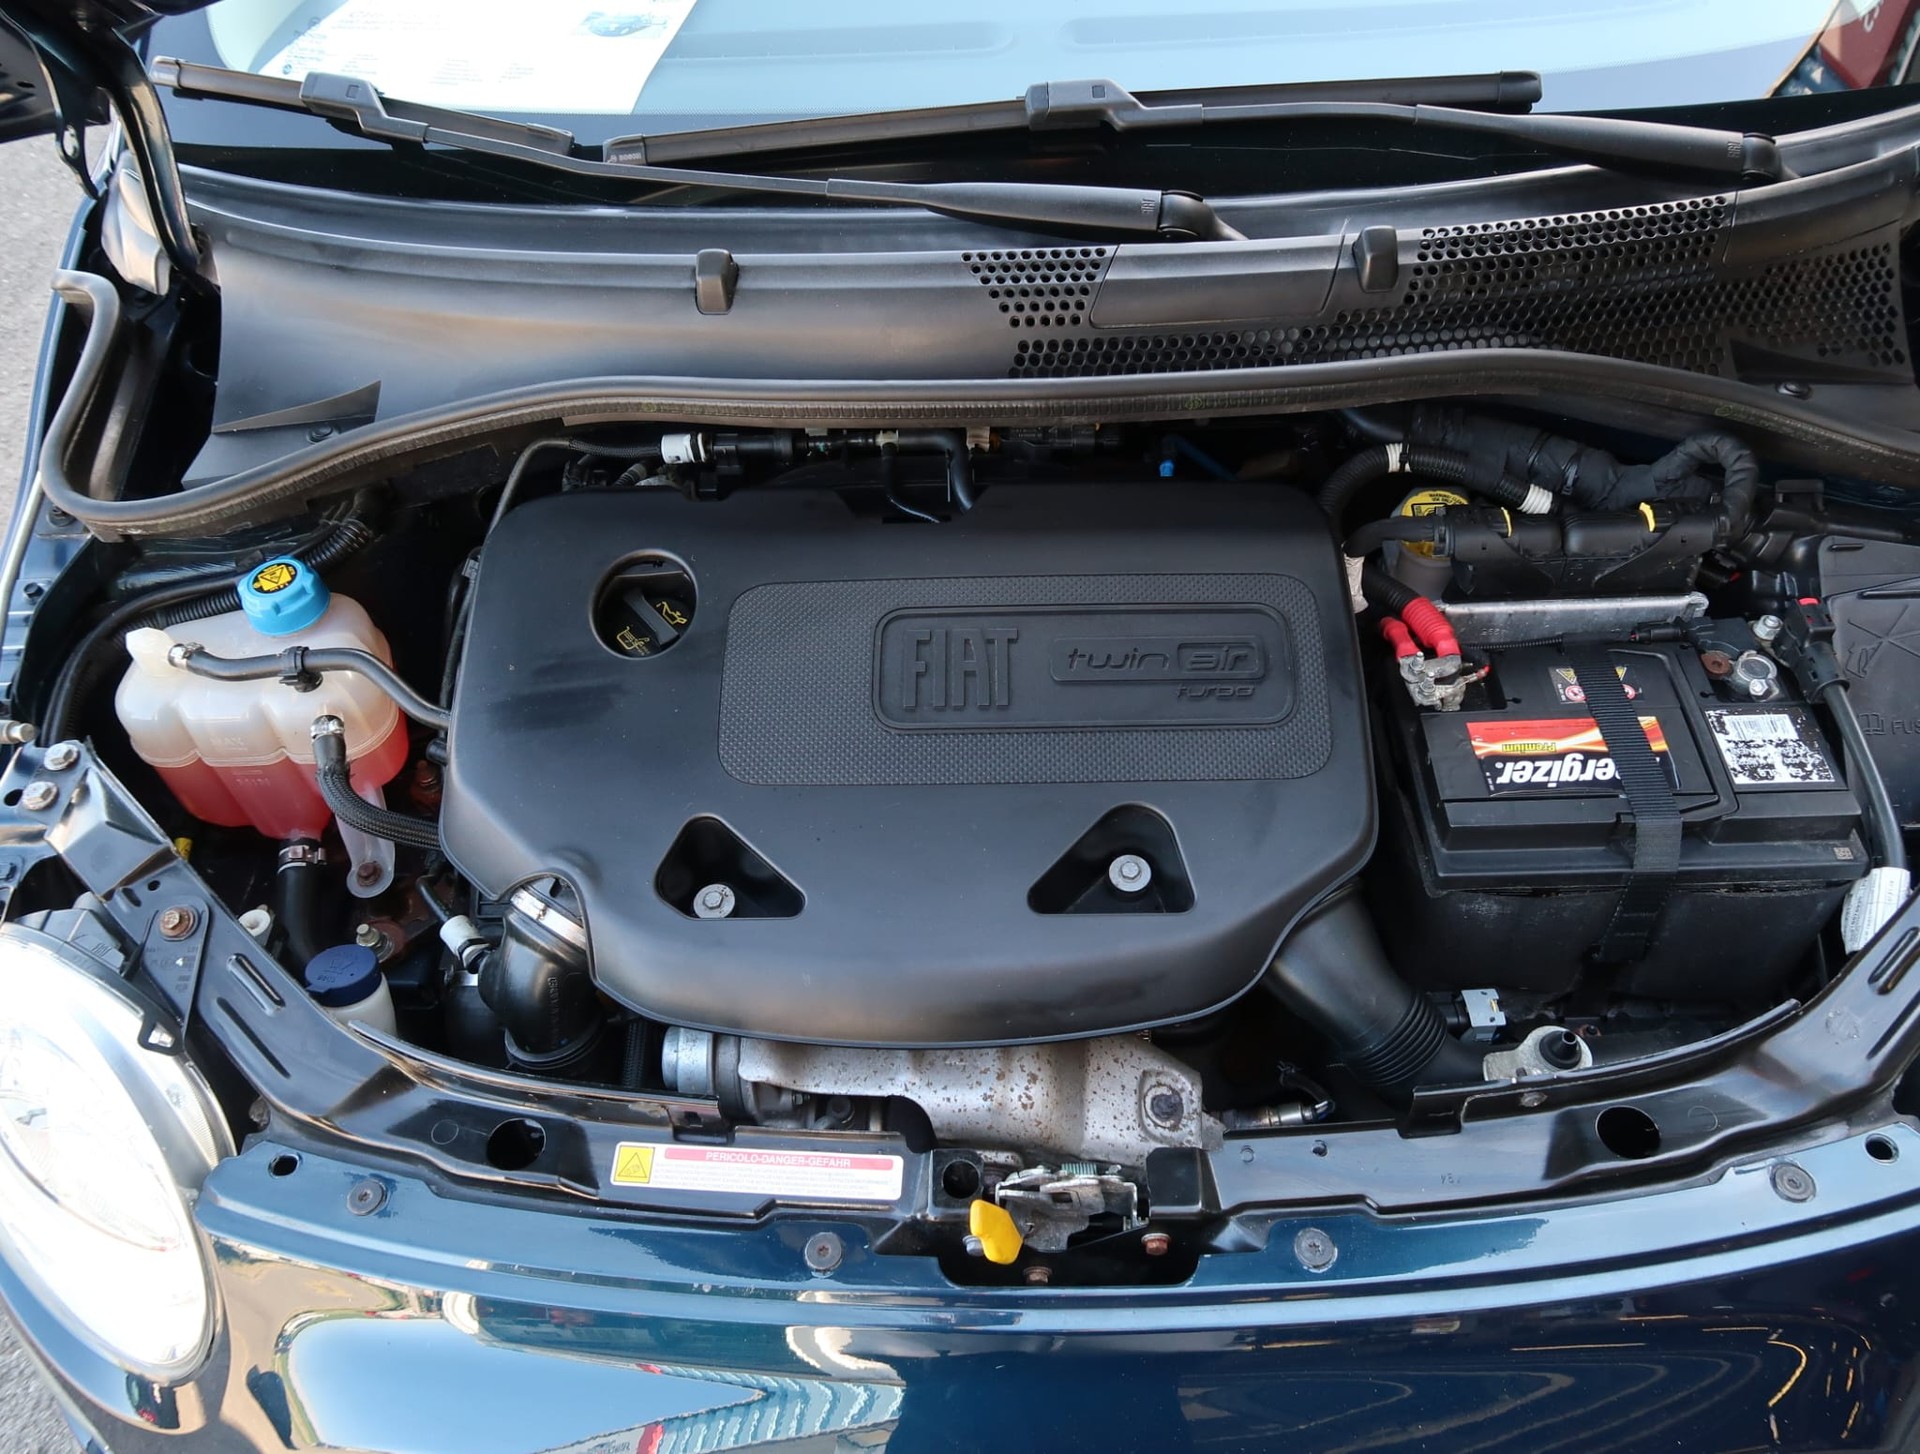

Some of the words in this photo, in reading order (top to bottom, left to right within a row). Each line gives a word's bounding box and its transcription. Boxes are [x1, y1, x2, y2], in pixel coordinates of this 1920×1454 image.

[903, 628, 1019, 711] FIAT
[1068, 646, 1170, 672] twin
[1187, 645, 1250, 672] air
[1174, 682, 1256, 699] turbo
[1501, 742, 1557, 754] Premium
[1495, 752, 1660, 788] ergizer
[705, 1151, 851, 1168] PERICOLO-DANGER-GEFAHR
